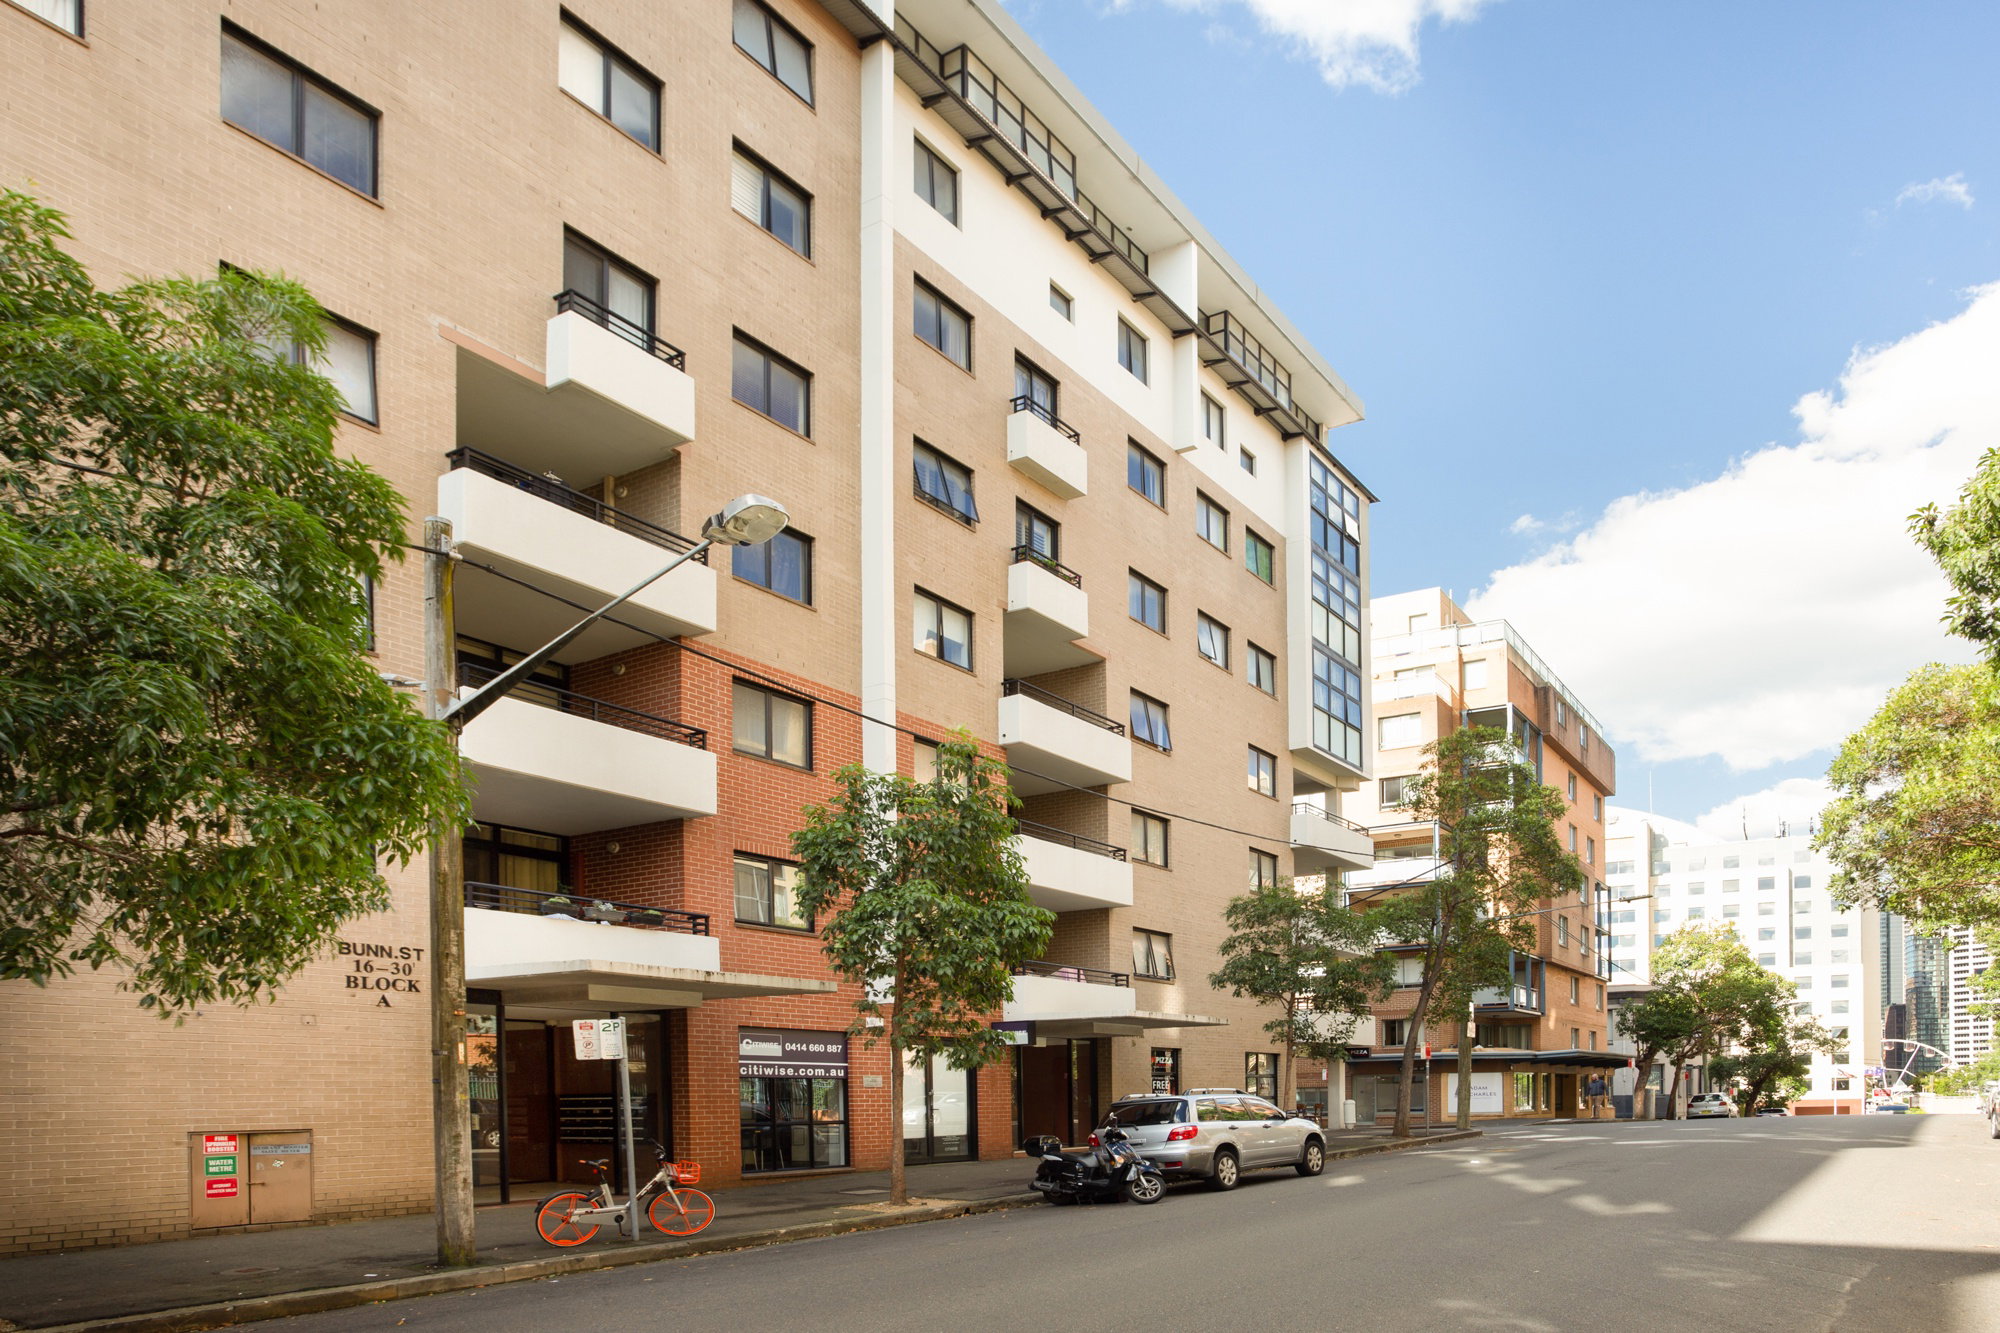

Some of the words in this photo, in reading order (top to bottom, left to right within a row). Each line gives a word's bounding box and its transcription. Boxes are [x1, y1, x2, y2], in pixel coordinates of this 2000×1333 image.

[344, 975, 421, 993] BLOCK
[375, 994, 392, 1008] A
[601, 1022, 620, 1032] 2P
[785, 1042, 807, 1052] 0414
[808, 1043, 825, 1053] 660
[826, 1044, 842, 1054] 887
[1155, 1056, 1173, 1064] PIZZA
[739, 1064, 845, 1077] citiwise.com.au
[1152, 1080, 1170, 1090] FREE
